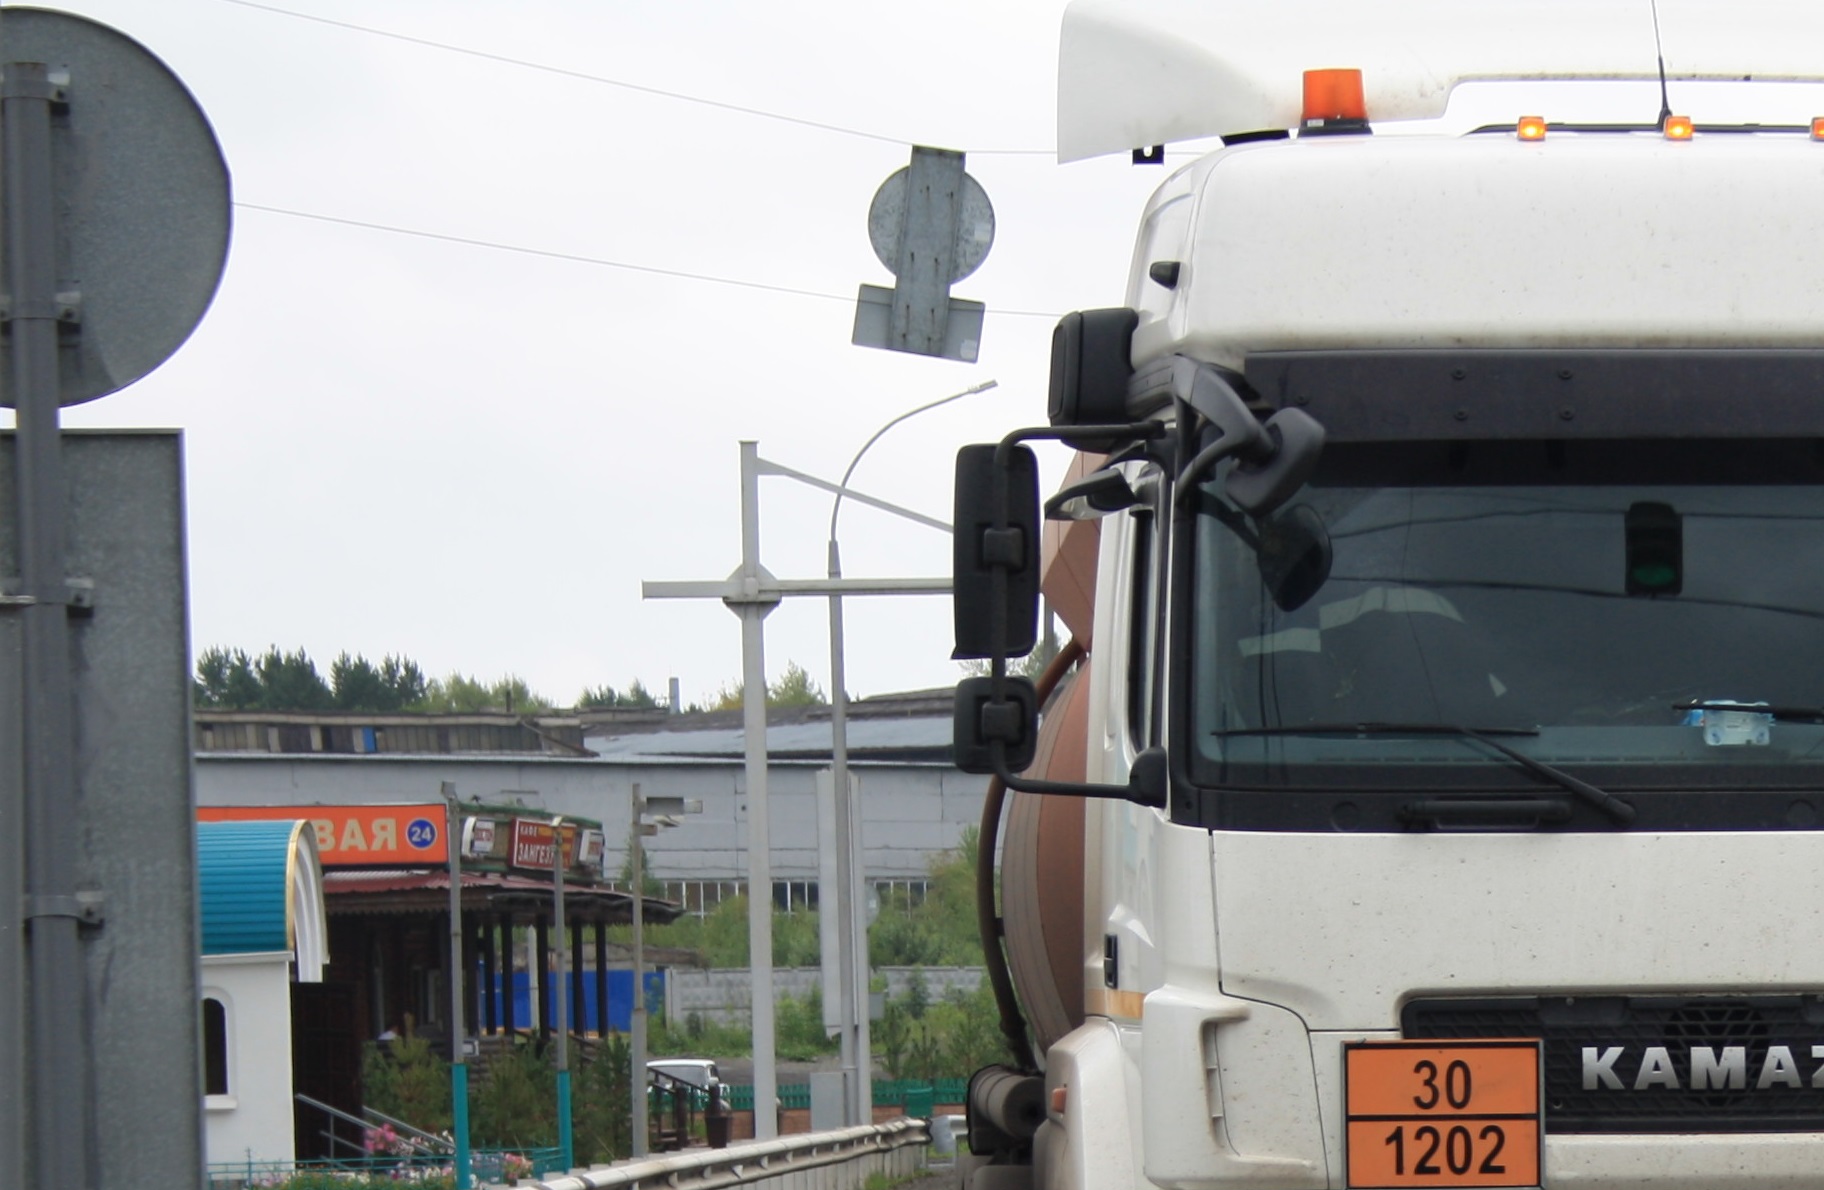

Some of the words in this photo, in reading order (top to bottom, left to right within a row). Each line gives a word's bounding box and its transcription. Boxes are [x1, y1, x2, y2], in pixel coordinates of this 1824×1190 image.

[410, 826, 433, 843] 24
[1413, 1059, 1472, 1110] 30
[1385, 1125, 1506, 1176] 1202
